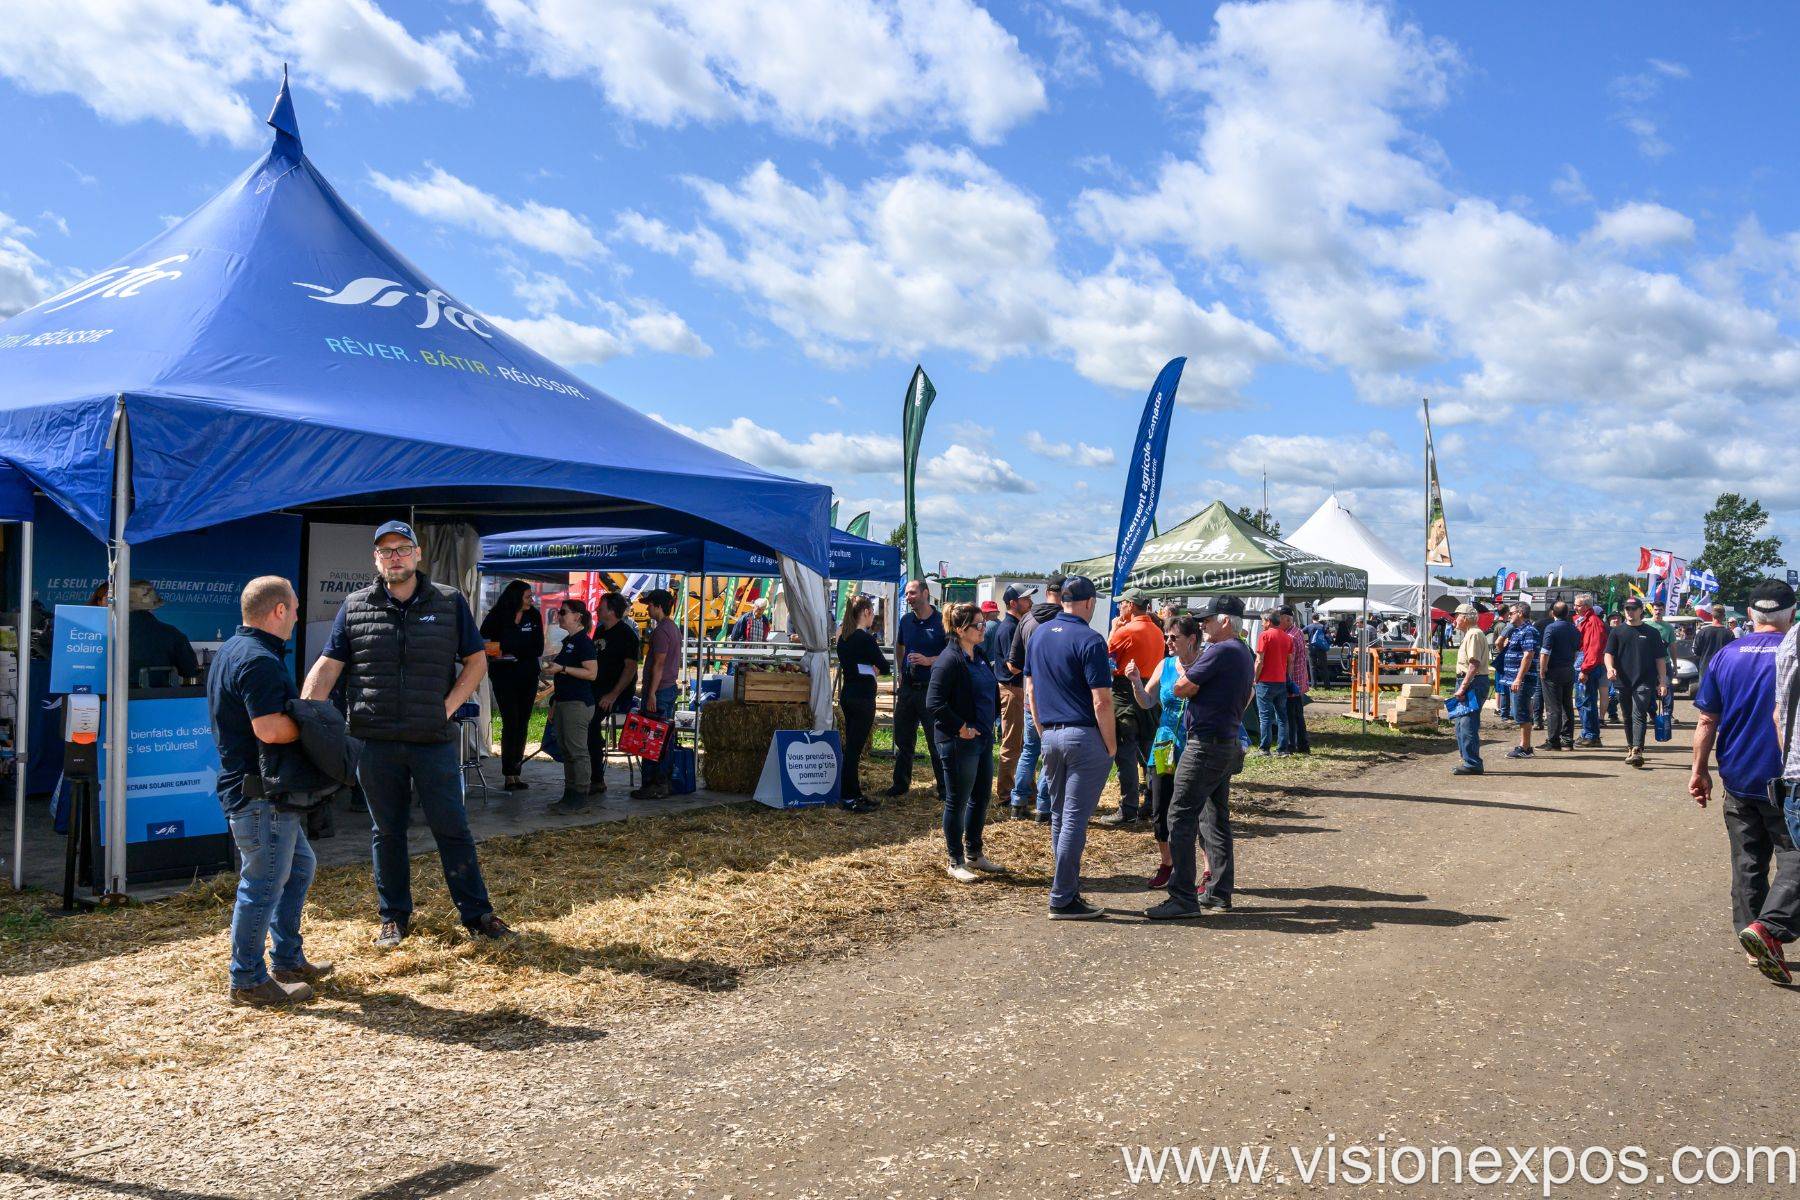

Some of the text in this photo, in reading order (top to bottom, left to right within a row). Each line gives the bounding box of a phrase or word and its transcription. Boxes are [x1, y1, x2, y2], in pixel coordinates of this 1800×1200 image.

[1142, 441, 1151, 492] agricole
[48, 579, 62, 588] LE
[64, 579, 89, 589] SEUL
[1132, 569, 1197, 589] Mobile
[1202, 568, 1273, 590] Gilbert
[69, 627, 103, 641] Écran
[66, 643, 104, 654] solaire
[130, 728, 173, 740] bienfaits
[176, 727, 190, 737] du
[137, 743, 152, 753] les
[154, 740, 199, 753] brûlures!
[805, 752, 834, 761] prendrez
[799, 770, 827, 780] pomme?
[149, 780, 174, 790] SOLAIRE
[175, 779, 201, 787] GRATUIT
